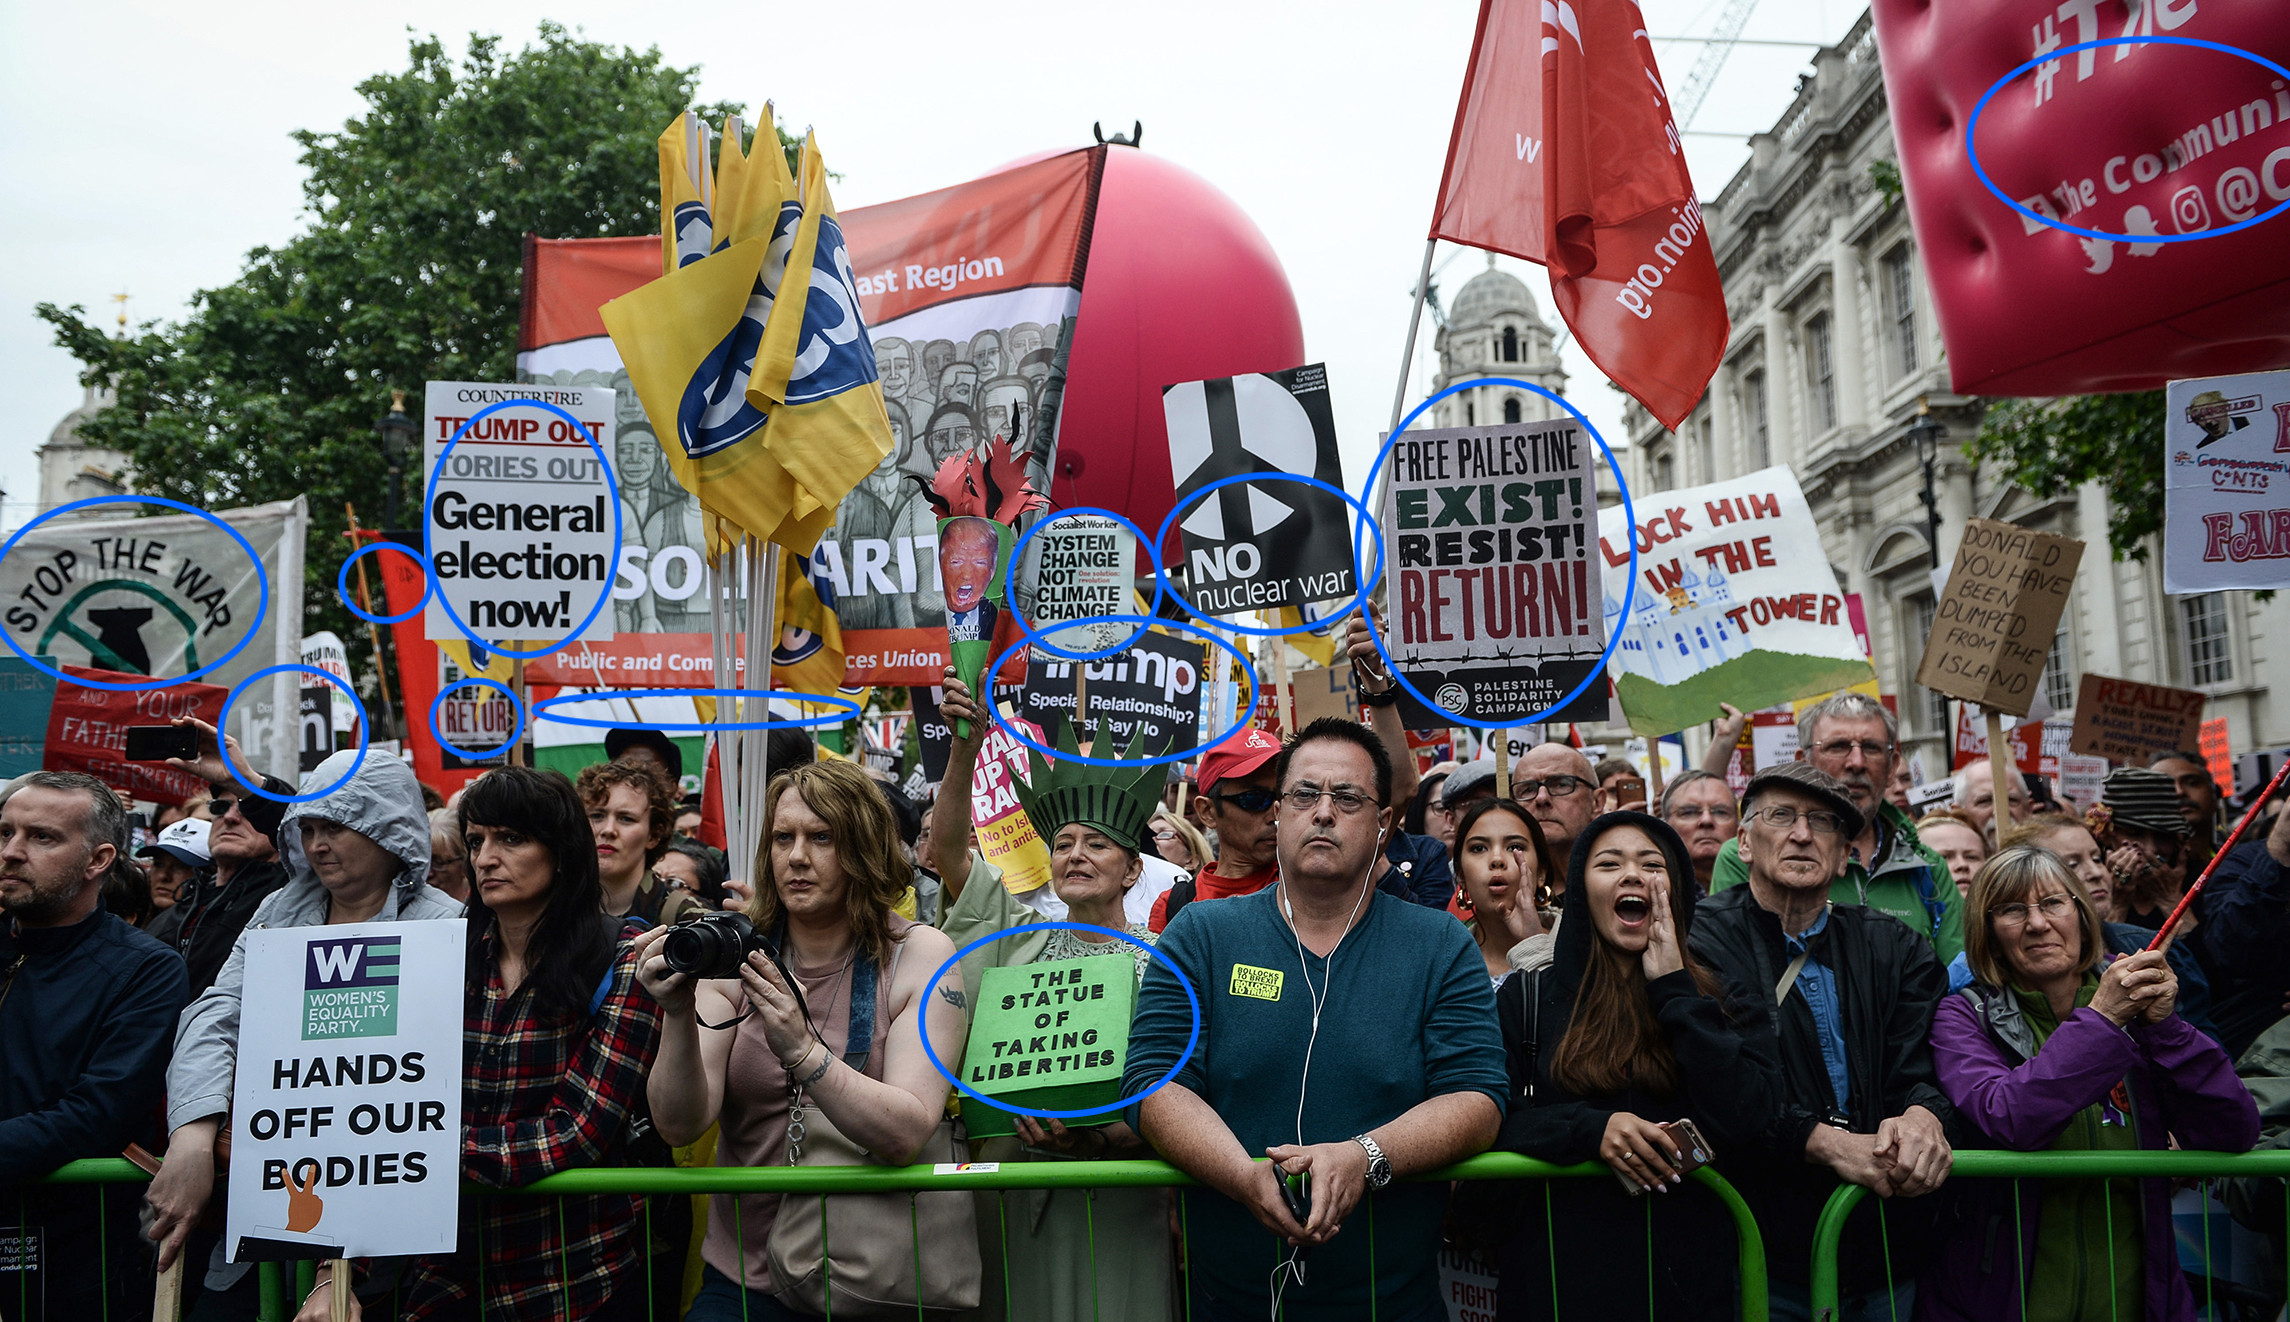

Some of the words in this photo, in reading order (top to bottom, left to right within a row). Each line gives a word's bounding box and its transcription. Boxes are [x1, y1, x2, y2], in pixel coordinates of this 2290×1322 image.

[851, 268, 899, 297] ast
[905, 256, 1005, 291] Region
[457, 389, 583, 406] COUNTERFIRE
[434, 416, 540, 442] TRUMP
[547, 420, 606, 445] OUT
[546, 457, 603, 482] OUT
[1394, 439, 1450, 482] FREE
[1457, 429, 1580, 479] PALESTINE
[432, 490, 606, 533] General
[1396, 477, 1584, 530] EXIST!
[1052, 520, 1087, 531] Socialist
[1087, 520, 1119, 530] Worker
[1600, 506, 1693, 569] LOCK
[1704, 493, 1782, 528] HIM
[1043, 535, 1116, 551] SYSTEM
[1398, 523, 1586, 568] RESIST!
[1963, 525, 2062, 568] DONALD
[432, 540, 606, 581] election
[1040, 551, 1120, 568] CHANGE
[1190, 542, 1262, 585] NO
[1644, 558, 1685, 595] IN
[1695, 535, 1777, 575] THE
[1957, 548, 2000, 581] YOU
[2007, 562, 2073, 596] HAVE
[5, 549, 77, 634] STOP
[92, 537, 167, 575] THE
[171, 558, 232, 638] WAR
[1037, 569, 1076, 586] NOT
[1195, 578, 1291, 612] nuclear
[1298, 568, 1350, 599] war
[1036, 586, 1121, 604] CLIMATE
[1400, 560, 1590, 645] RETURN!
[1959, 579, 2020, 609] BEEN
[469, 590, 571, 629] now!
[1035, 603, 1118, 621] CHANGE
[1725, 592, 1842, 635] TOWER
[1940, 598, 2028, 639] DUMPED
[556, 652, 617, 670] Public
[621, 653, 663, 671] and
[882, 649, 942, 668] Union
[1945, 626, 1998, 654] FROM
[2003, 640, 2043, 666] THE
[1474, 679, 1554, 692] PALESTINE
[1938, 653, 2029, 696] ISLAND
[78, 689, 110, 707] AND
[134, 689, 204, 720] YOUR
[1029, 692, 1078, 711] Specia
[1089, 696, 1196, 725] Relationship?
[1442, 694, 1462, 706] PSC
[1474, 689, 1564, 703] SOLIDARITY
[1475, 702, 1553, 715] CAMPAIGN
[240, 706, 329, 758] Irn
[972, 759, 1004, 796] UP
[982, 829, 1001, 844] No
[1001, 823, 1015, 836] to
[988, 842, 1010, 858] and
[1030, 968, 1083, 989] THE
[1234, 980, 1278, 993] BOLLOCKS
[1237, 966, 1280, 980] BOLLOCKS
[1249, 975, 1278, 985] BREXIT
[309, 990, 387, 1008] WOMEN'S
[1001, 983, 1105, 1011] STATUE
[1234, 986, 1246, 994] TO
[1247, 987, 1276, 998] TRUMP
[308, 1003, 391, 1022] EQUALITY
[1034, 1010, 1070, 1029] OF
[307, 1020, 364, 1036] PARTY.
[991, 1029, 1098, 1058] TAKING
[272, 1051, 426, 1090] HANDS
[971, 1049, 1115, 1083] LIBERTIES
[249, 1106, 334, 1141] OFF
[348, 1100, 446, 1136] OUR
[262, 1151, 428, 1191] BODIES
[4, 1245, 38, 1254] Nucear
[1451, 1280, 1497, 1312] FIGHT
